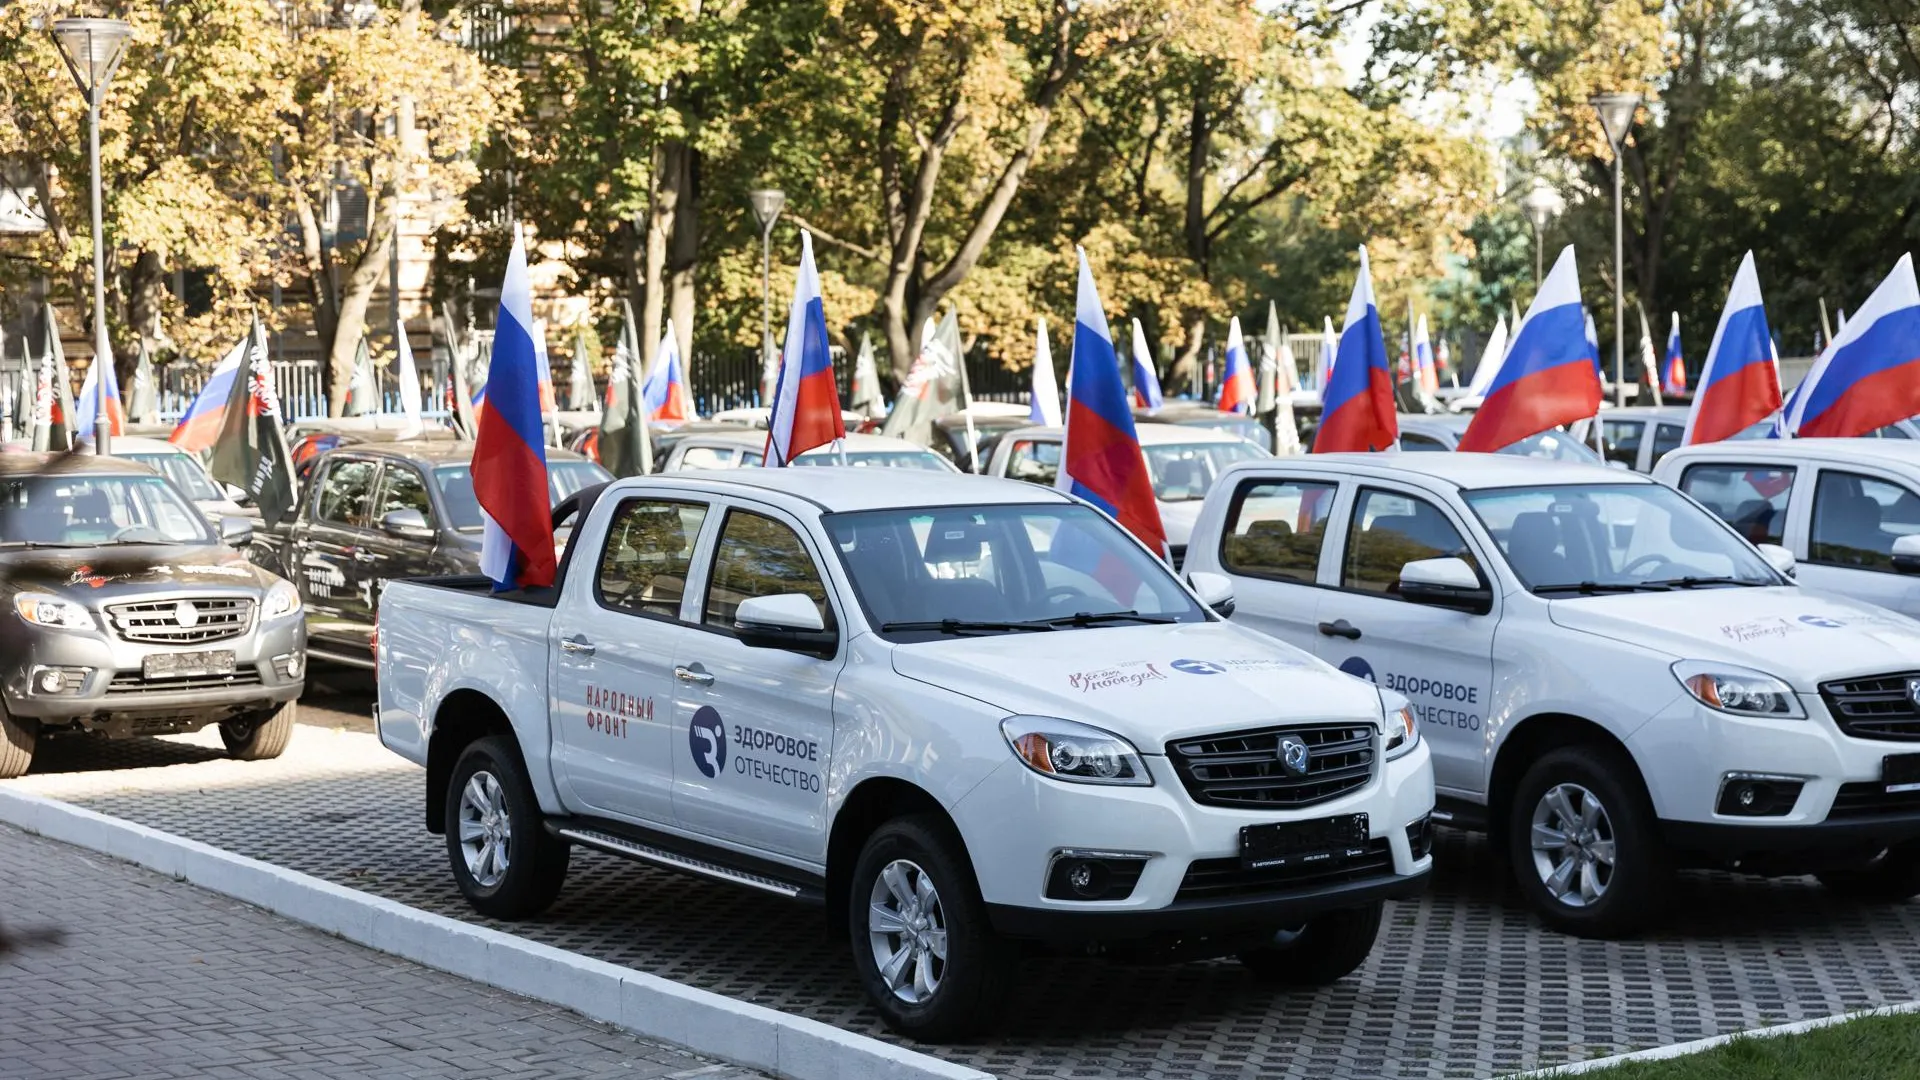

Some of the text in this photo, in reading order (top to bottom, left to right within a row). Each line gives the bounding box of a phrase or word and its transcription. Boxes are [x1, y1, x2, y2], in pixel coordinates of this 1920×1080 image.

[587, 685, 654, 721] НАРОДНЫЙ
[1385, 672, 1478, 704] ЗДОРОВОЕ
[587, 709, 628, 739] ФРОНТ
[1414, 702, 1480, 731] ЧЕСТВО
[734, 725, 818, 762] ЗДОРОВОЕ
[734, 756, 820, 793] ОТЕЧЕСТВО
